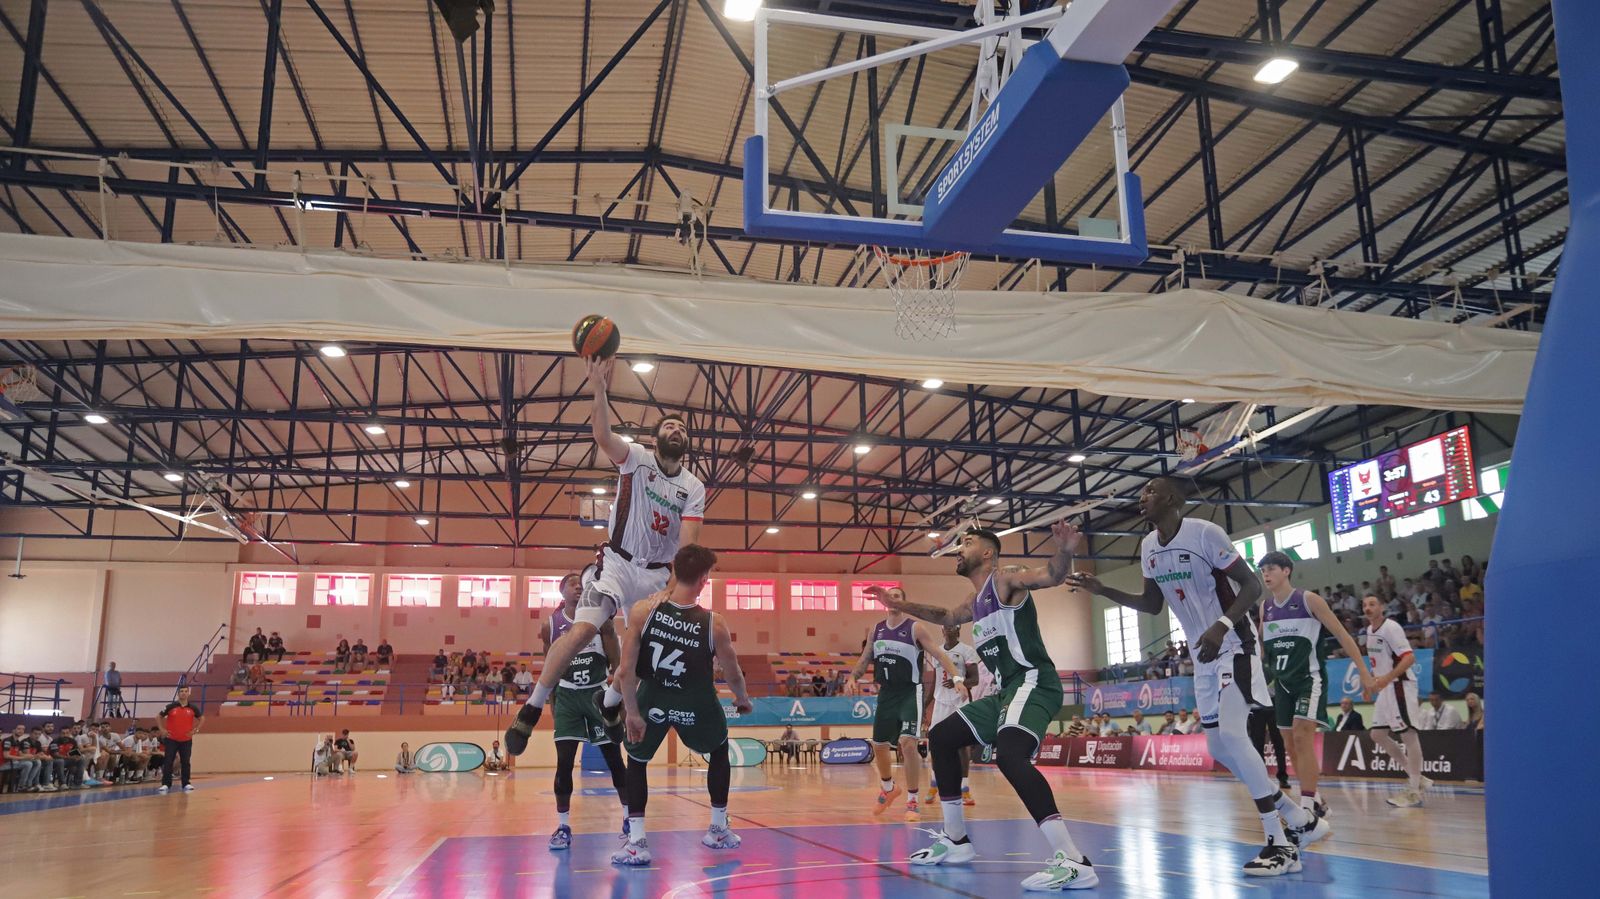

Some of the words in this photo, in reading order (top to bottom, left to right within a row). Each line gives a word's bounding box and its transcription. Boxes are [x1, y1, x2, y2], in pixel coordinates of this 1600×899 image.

[937, 101, 1001, 199] SPORTSYSTEM
[1423, 489, 1441, 503] 43
[651, 511, 670, 536] 32
[1155, 571, 1192, 583] COVIRAN
[649, 641, 687, 676] 14
[1276, 654, 1289, 671] 17
[573, 669, 591, 685] 55
[883, 667, 889, 680] 1
[668, 709, 695, 718] COSTA
[1098, 740, 1122, 751] Diputación
[1160, 742, 1181, 753] Junta
[1372, 742, 1407, 754] Jua
[1096, 755, 1103, 764] de
[1103, 754, 1117, 765] Cádiz
[1159, 755, 1168, 766] de
[1168, 754, 1203, 766] Andalucía
[1371, 756, 1386, 771] de
